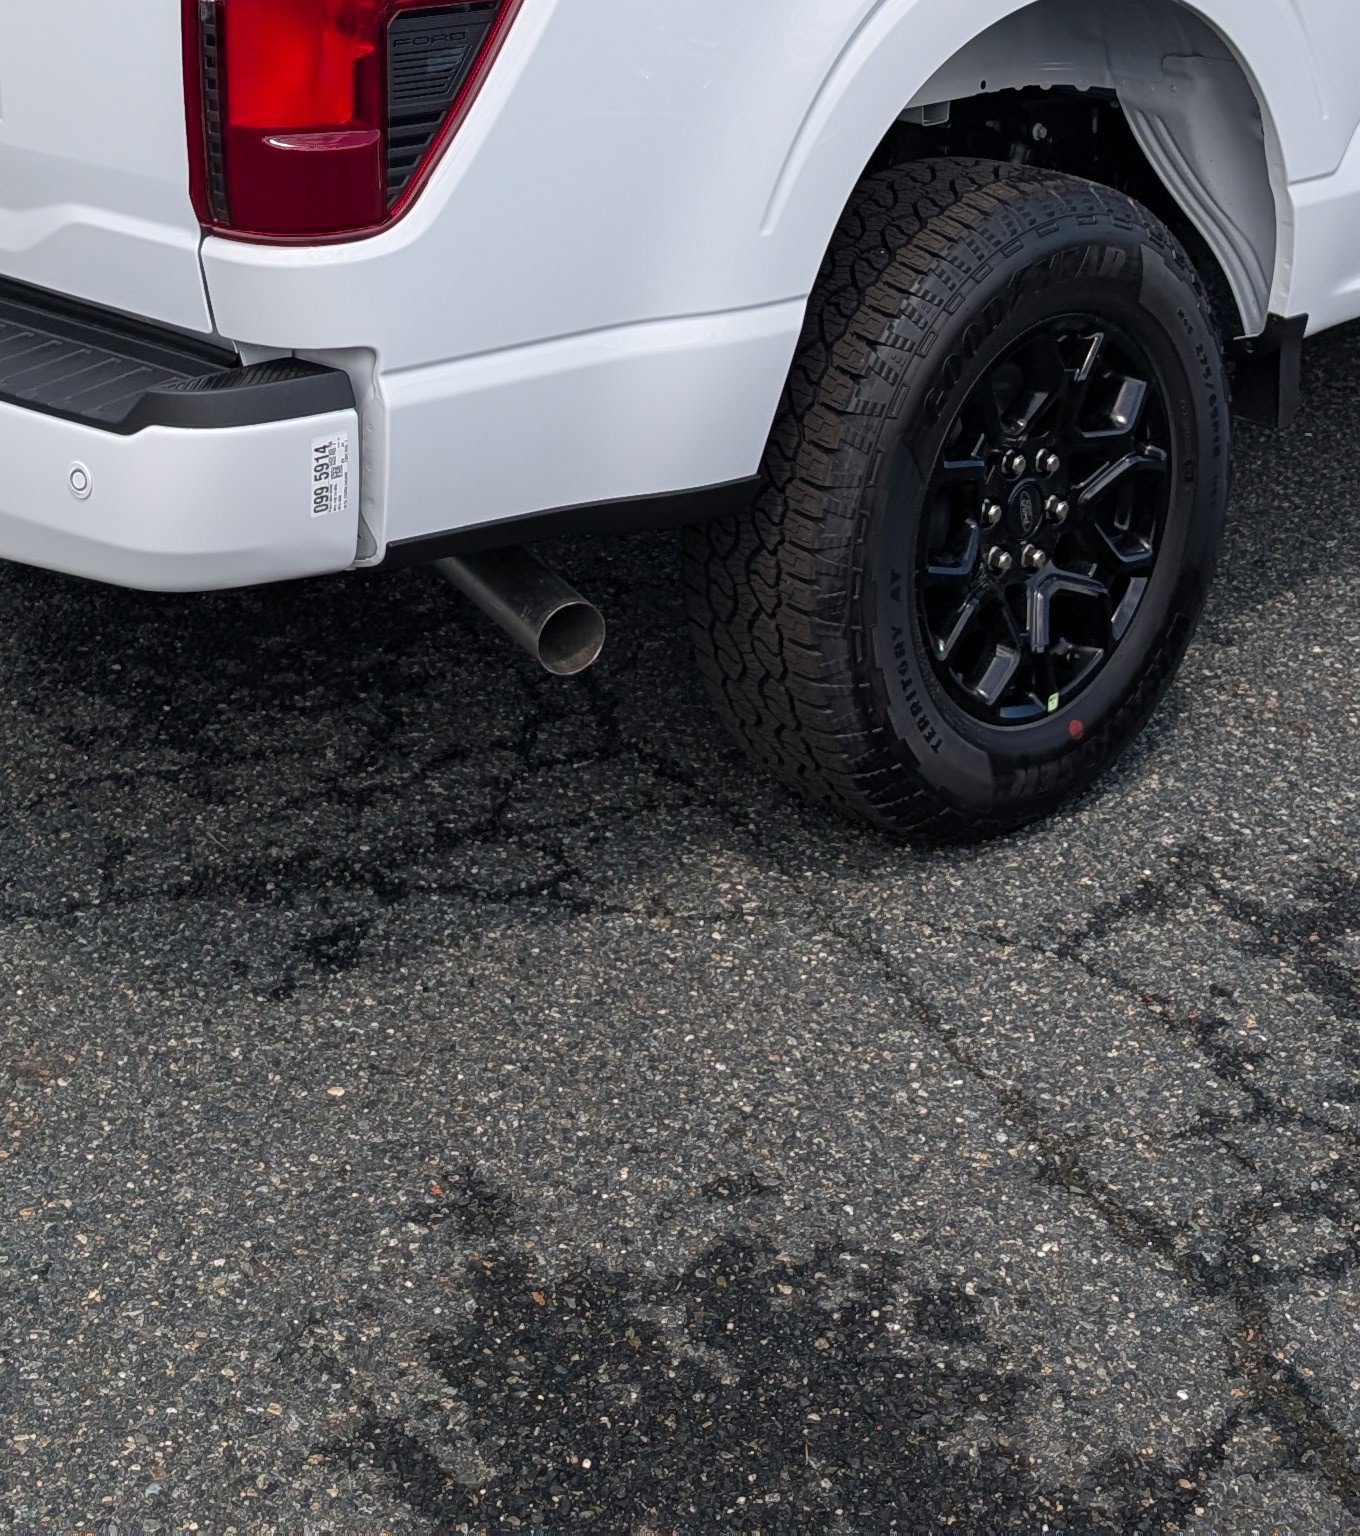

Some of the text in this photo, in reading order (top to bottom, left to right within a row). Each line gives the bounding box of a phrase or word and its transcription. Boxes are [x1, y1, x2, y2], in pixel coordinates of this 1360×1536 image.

[393, 32, 466, 47] FORD
[313, 444, 330, 514] 099 5914
[890, 624, 943, 754] TERRITORY
